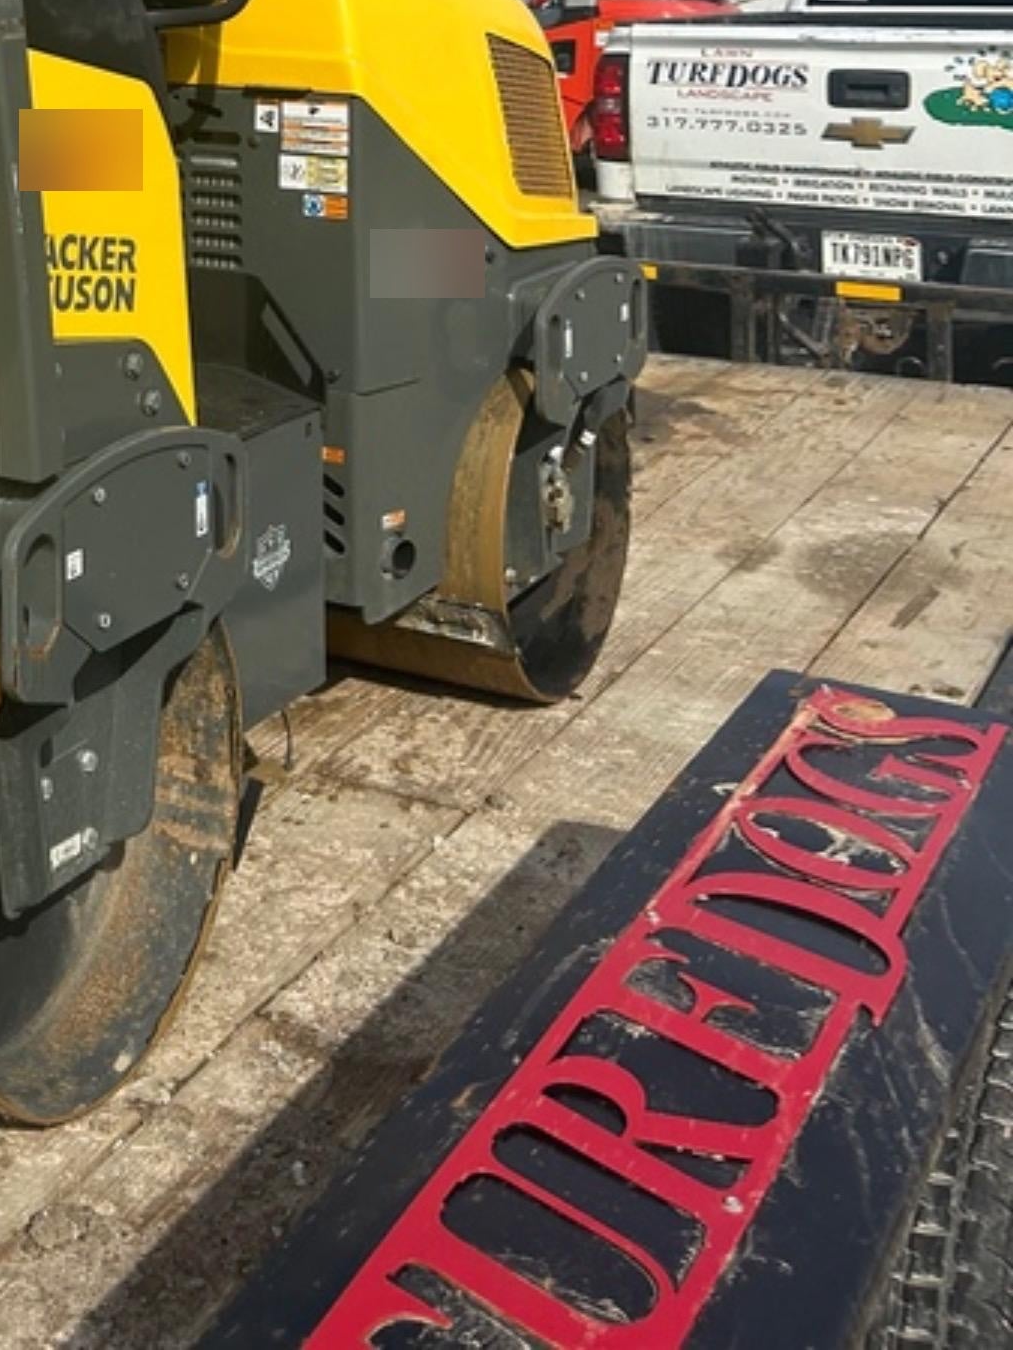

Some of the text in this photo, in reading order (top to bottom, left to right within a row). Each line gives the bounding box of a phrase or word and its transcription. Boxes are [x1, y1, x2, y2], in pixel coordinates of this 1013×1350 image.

[646, 59, 809, 89] TURFDOGS
[677, 89, 773, 102] LANDSCAPE
[646, 116, 808, 136] 317.777.0325
[45, 234, 137, 273] ACKER
[49, 275, 136, 313] USON
